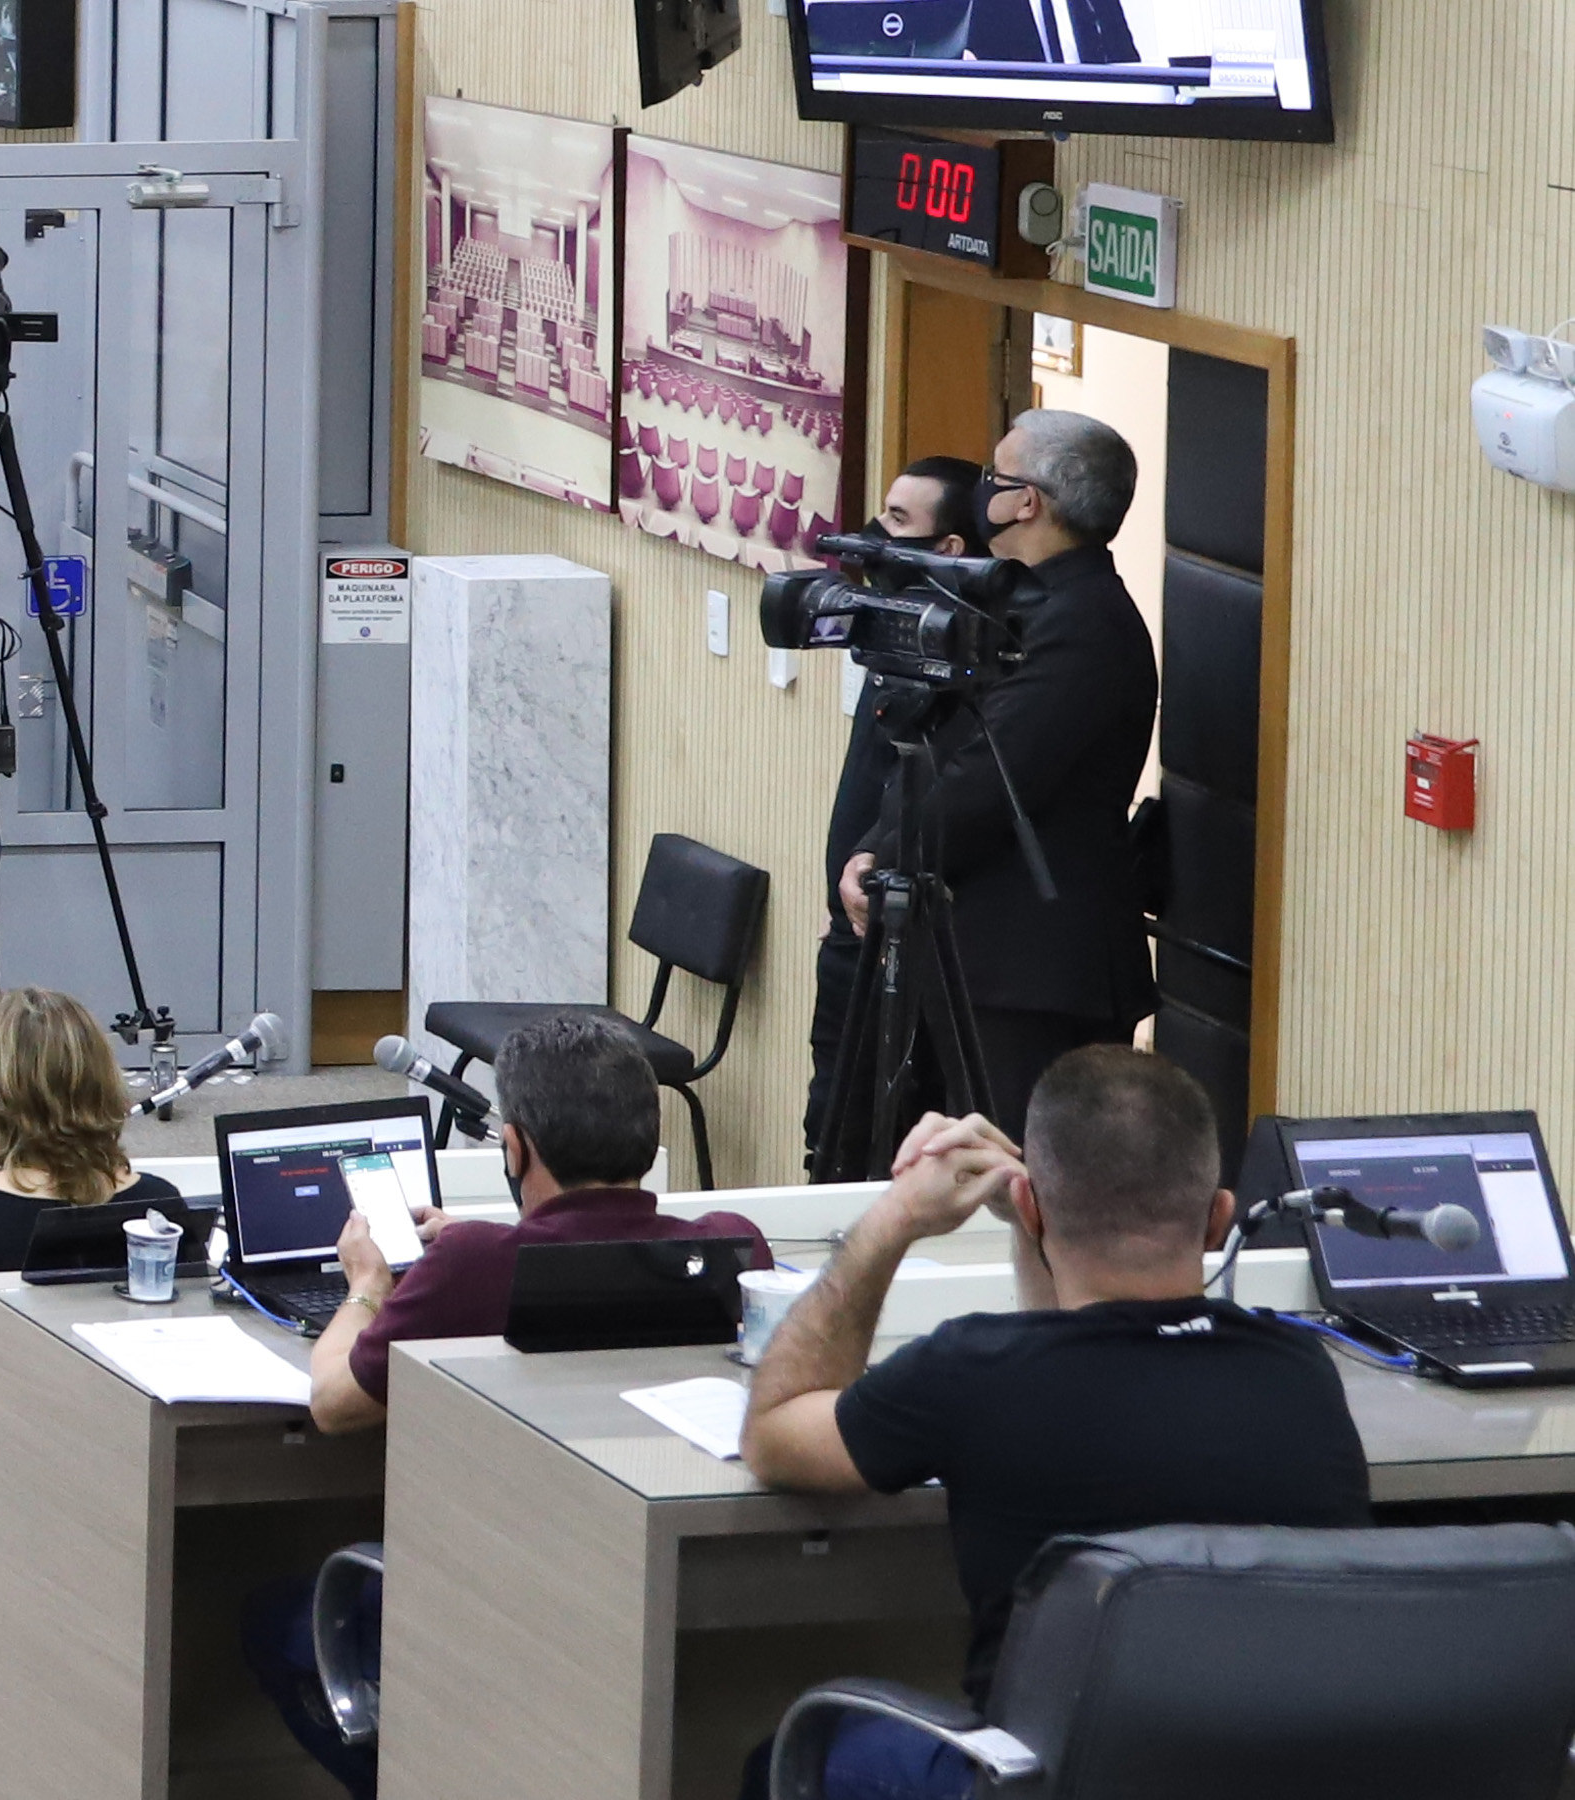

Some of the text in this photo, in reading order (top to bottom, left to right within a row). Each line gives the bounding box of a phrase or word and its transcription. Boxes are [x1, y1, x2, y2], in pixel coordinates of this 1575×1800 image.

[947, 232, 989, 257] ARTDATA
[341, 563, 394, 574] PERIGO
[338, 584, 396, 592] MAQUINARIA
[328, 594, 405, 603] DA PLATAFORMA
